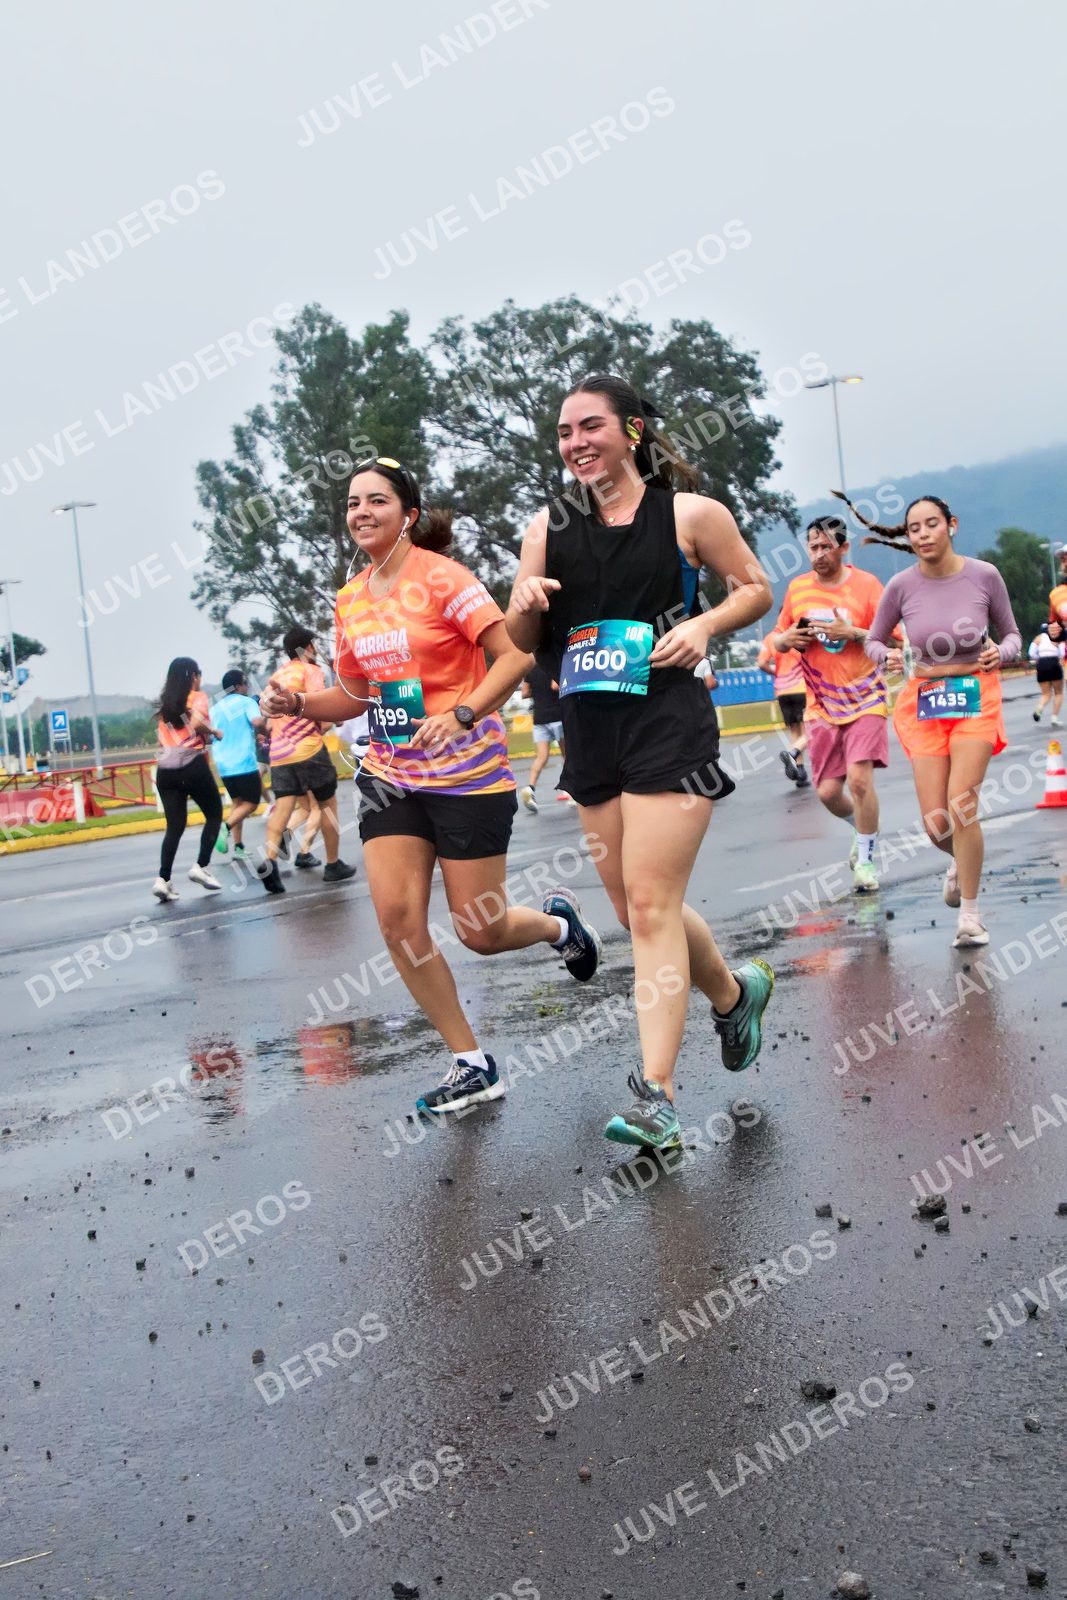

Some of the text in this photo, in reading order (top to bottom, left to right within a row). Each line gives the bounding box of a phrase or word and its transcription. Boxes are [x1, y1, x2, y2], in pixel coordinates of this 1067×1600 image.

[354, 627, 409, 659] CARRERA
[569, 626, 645, 645] CARRERA 10K
[573, 650, 627, 673] 1600
[398, 684, 415, 698] 10K
[928, 692, 967, 708] 1435
[373, 708, 408, 726] 1599
